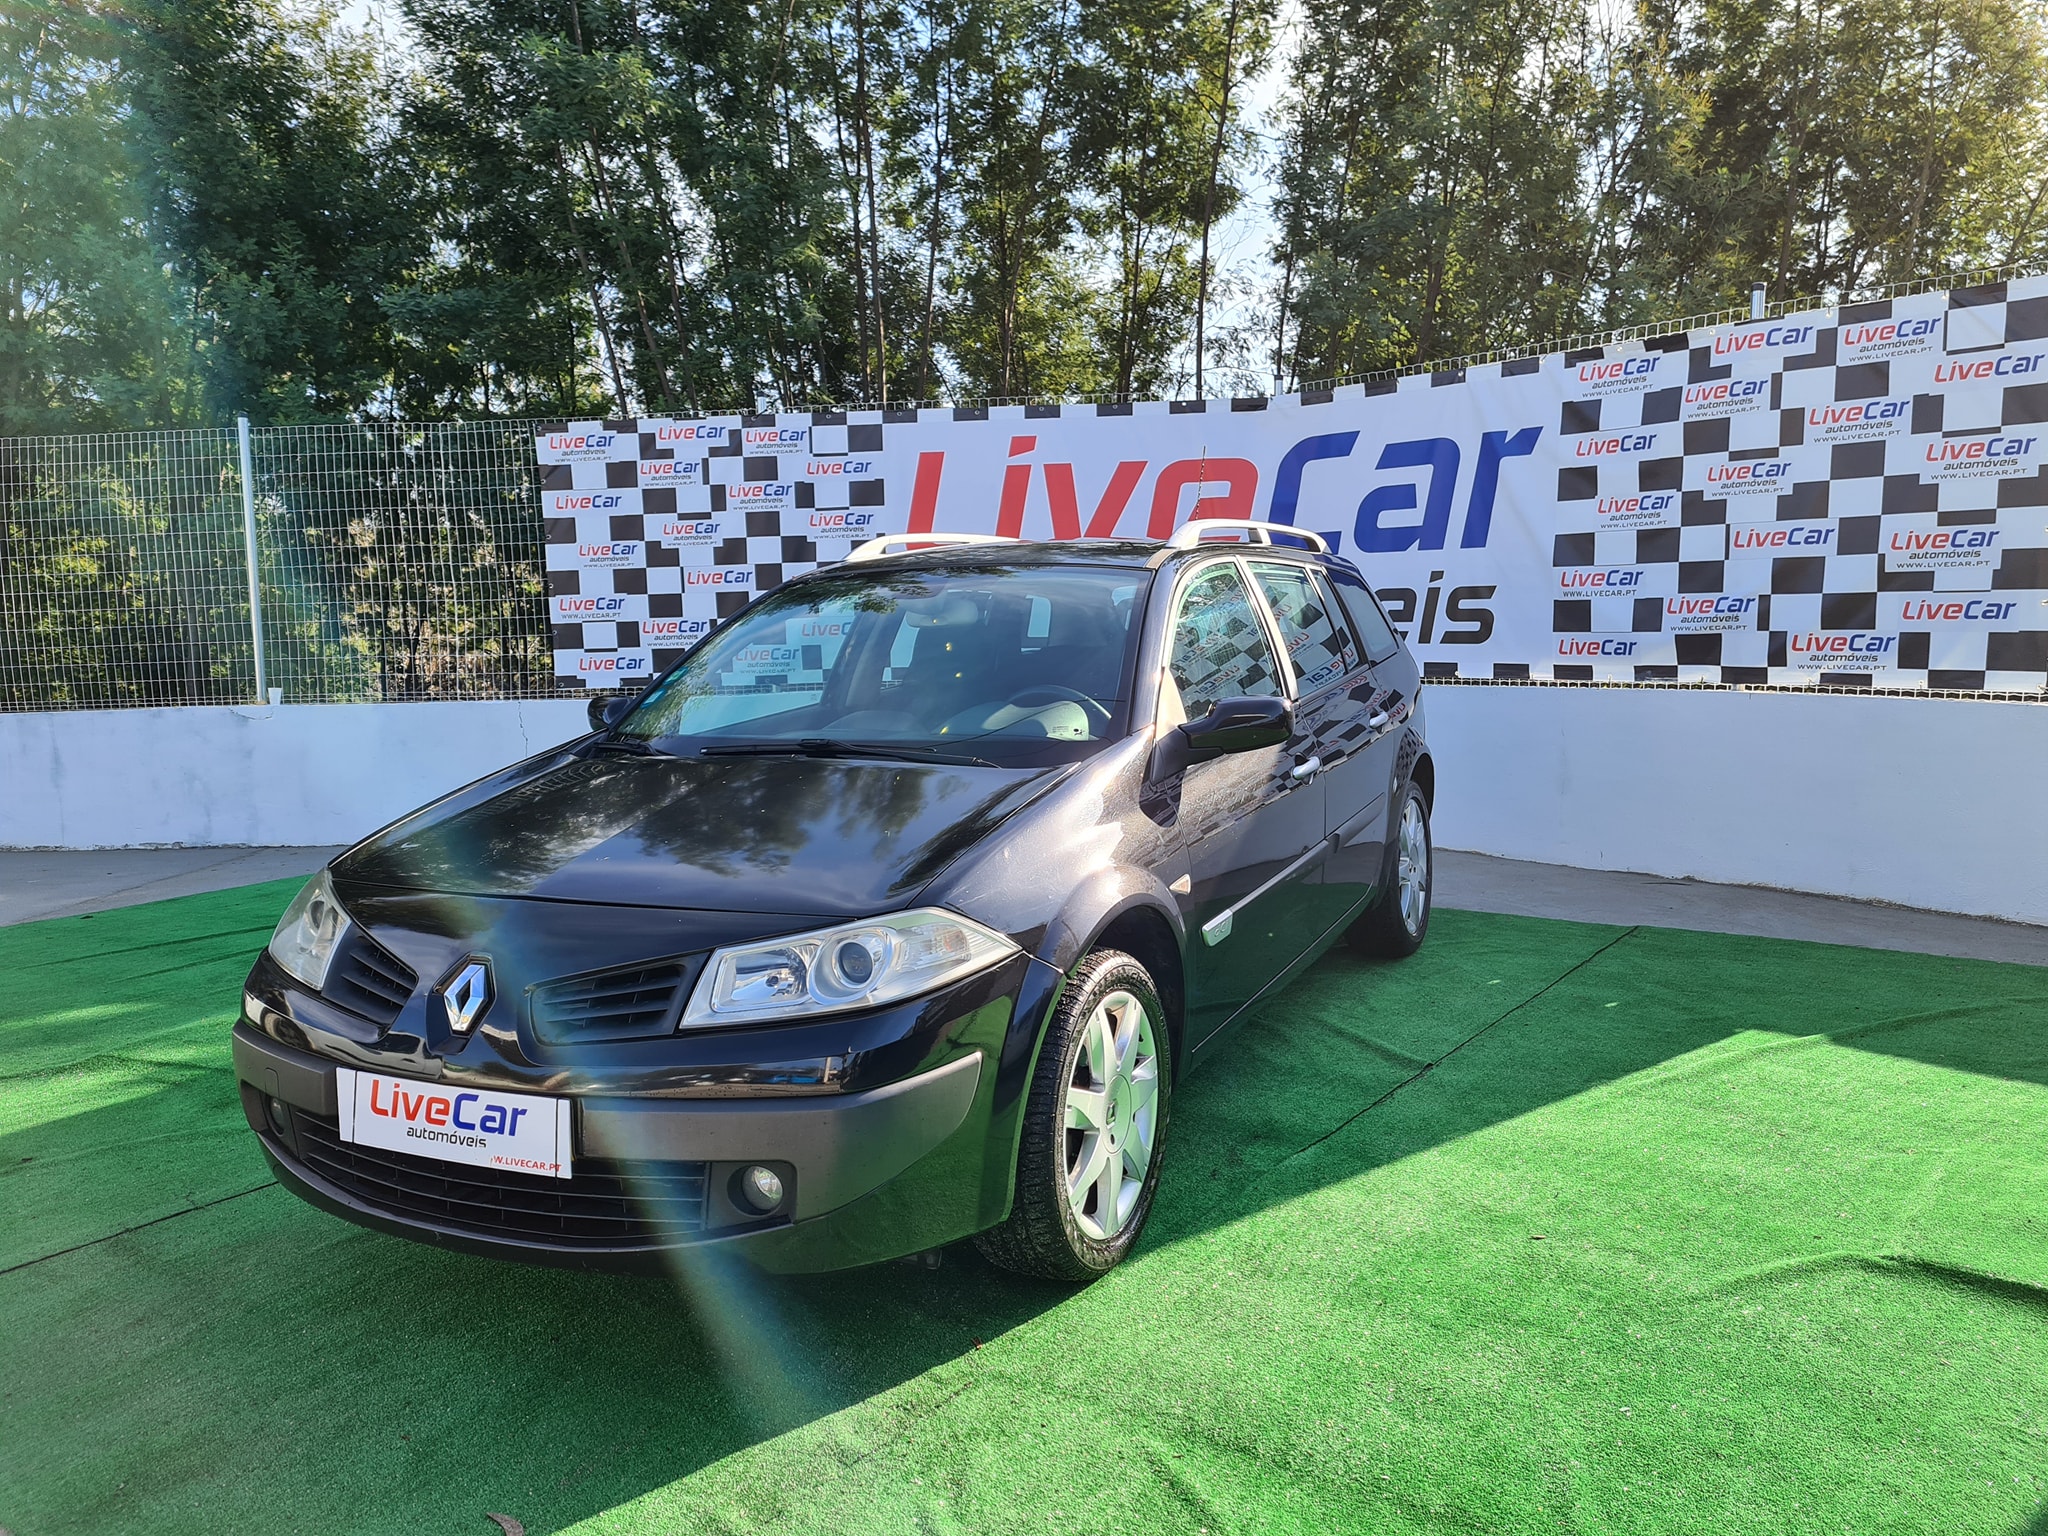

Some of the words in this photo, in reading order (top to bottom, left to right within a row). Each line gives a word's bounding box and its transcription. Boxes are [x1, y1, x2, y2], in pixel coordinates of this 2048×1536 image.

[1844, 318, 1942, 346] LiveCar
[1714, 326, 1814, 354] LiveCar
[1860, 337, 1925, 353] automóveis
[1849, 346, 1933, 362] WWW.LIVECAR.PT
[1579, 356, 1660, 382] LiveCar
[1934, 354, 2046, 383] LiveCar
[1592, 375, 1647, 389] automóveis
[1582, 384, 1653, 398] WWW.LIVECAR.PT
[1685, 380, 1768, 404] LiveCar
[1697, 397, 1753, 410] automóveis
[1688, 406, 1760, 418] WWW.LIVECAR.PT
[1809, 400, 1910, 426] LiveCar
[658, 426, 726, 440] LiveCar
[1825, 420, 1893, 434] automóveis
[550, 434, 615, 449] LiveCar
[746, 430, 807, 443] LiveCar
[1814, 430, 1901, 443] WWW.LIVECAR.PT
[1576, 434, 1657, 456] LiveCar
[1926, 437, 2038, 462] LiveCar
[640, 462, 700, 474] LiveCar
[806, 461, 872, 474] LiveCar
[1944, 458, 2018, 470] automóveis
[1708, 462, 1792, 482] LiveCar
[1931, 468, 2027, 480] WWW.LIVECAR.PT
[729, 484, 792, 498] LiveCar
[906, 426, 1543, 553] LiveCar
[1721, 478, 1777, 490] automóveis
[1712, 488, 1784, 497] WWW.LIVECAR.PT
[556, 495, 622, 510] LiveCar
[1598, 495, 1674, 514] LiveCar
[809, 513, 874, 526] LiveCar
[1600, 520, 1667, 528] WWW.LIVECAR.PT
[1610, 512, 1661, 522] automóveis
[663, 522, 720, 535] LiveCar
[1733, 528, 1836, 548] LiveCar
[1890, 530, 2000, 550] LiveCar
[579, 544, 637, 556] LiveCar
[1908, 550, 1981, 560] automóveis
[1896, 560, 1990, 568] WWW.LIVECAR.PT
[687, 570, 752, 584] LiveCar
[1560, 570, 1644, 588] LiveCar
[1562, 590, 1637, 598] WWW.LIVECAR.PT
[559, 597, 624, 612] LiveCar
[1666, 596, 1756, 614] LiveCar
[1902, 600, 2016, 620] LiveCar
[562, 612, 620, 620] WWW.LIVECAR.PT
[1680, 614, 1740, 624] automóveis
[643, 620, 707, 634] LiveCar
[1670, 624, 1748, 632] WWW.LIVECAR.PT
[1558, 638, 1637, 656] LiveCar
[1791, 633, 1896, 652] LiveCar
[736, 647, 799, 661] LiveCar
[1809, 653, 1878, 662] automóveis
[579, 657, 645, 671] LiveCar
[370, 1079, 528, 1137] LiveCar
[407, 1126, 486, 1148] automóveis
[491, 1155, 562, 1172] W.LIVECAR.PT
